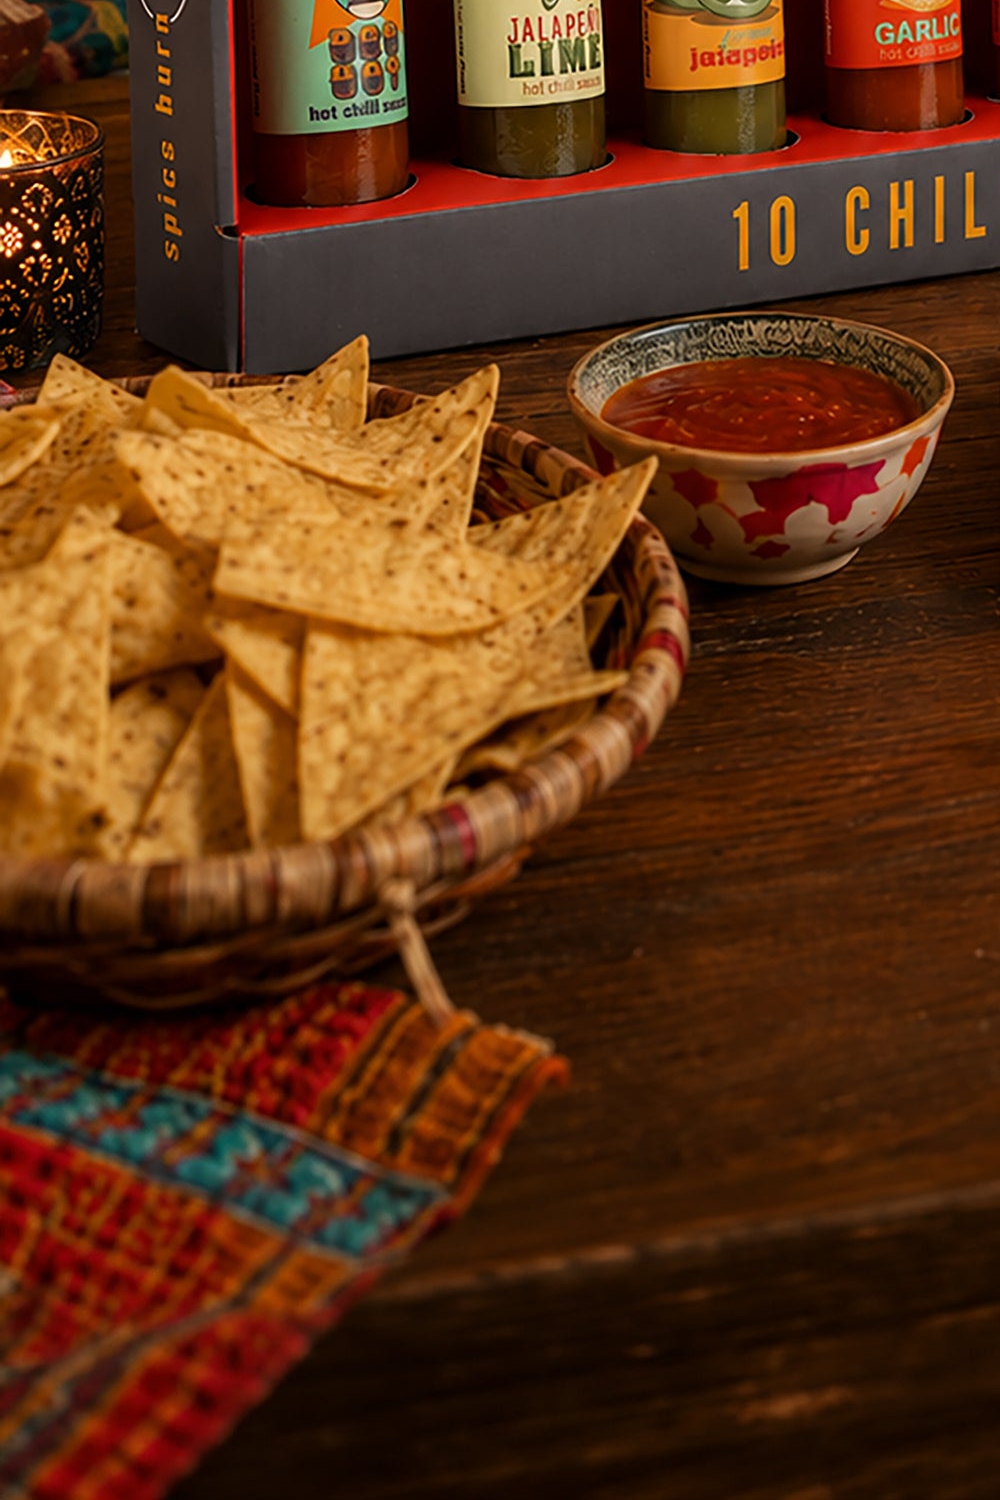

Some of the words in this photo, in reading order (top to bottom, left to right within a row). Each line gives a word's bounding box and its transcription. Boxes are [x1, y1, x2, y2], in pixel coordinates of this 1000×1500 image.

[874, 12, 960, 46] GARLIC
[154, 13, 173, 116] burn
[508, 32, 601, 79] LIME
[308, 105, 338, 121] hot
[731, 194, 797, 272] 10
